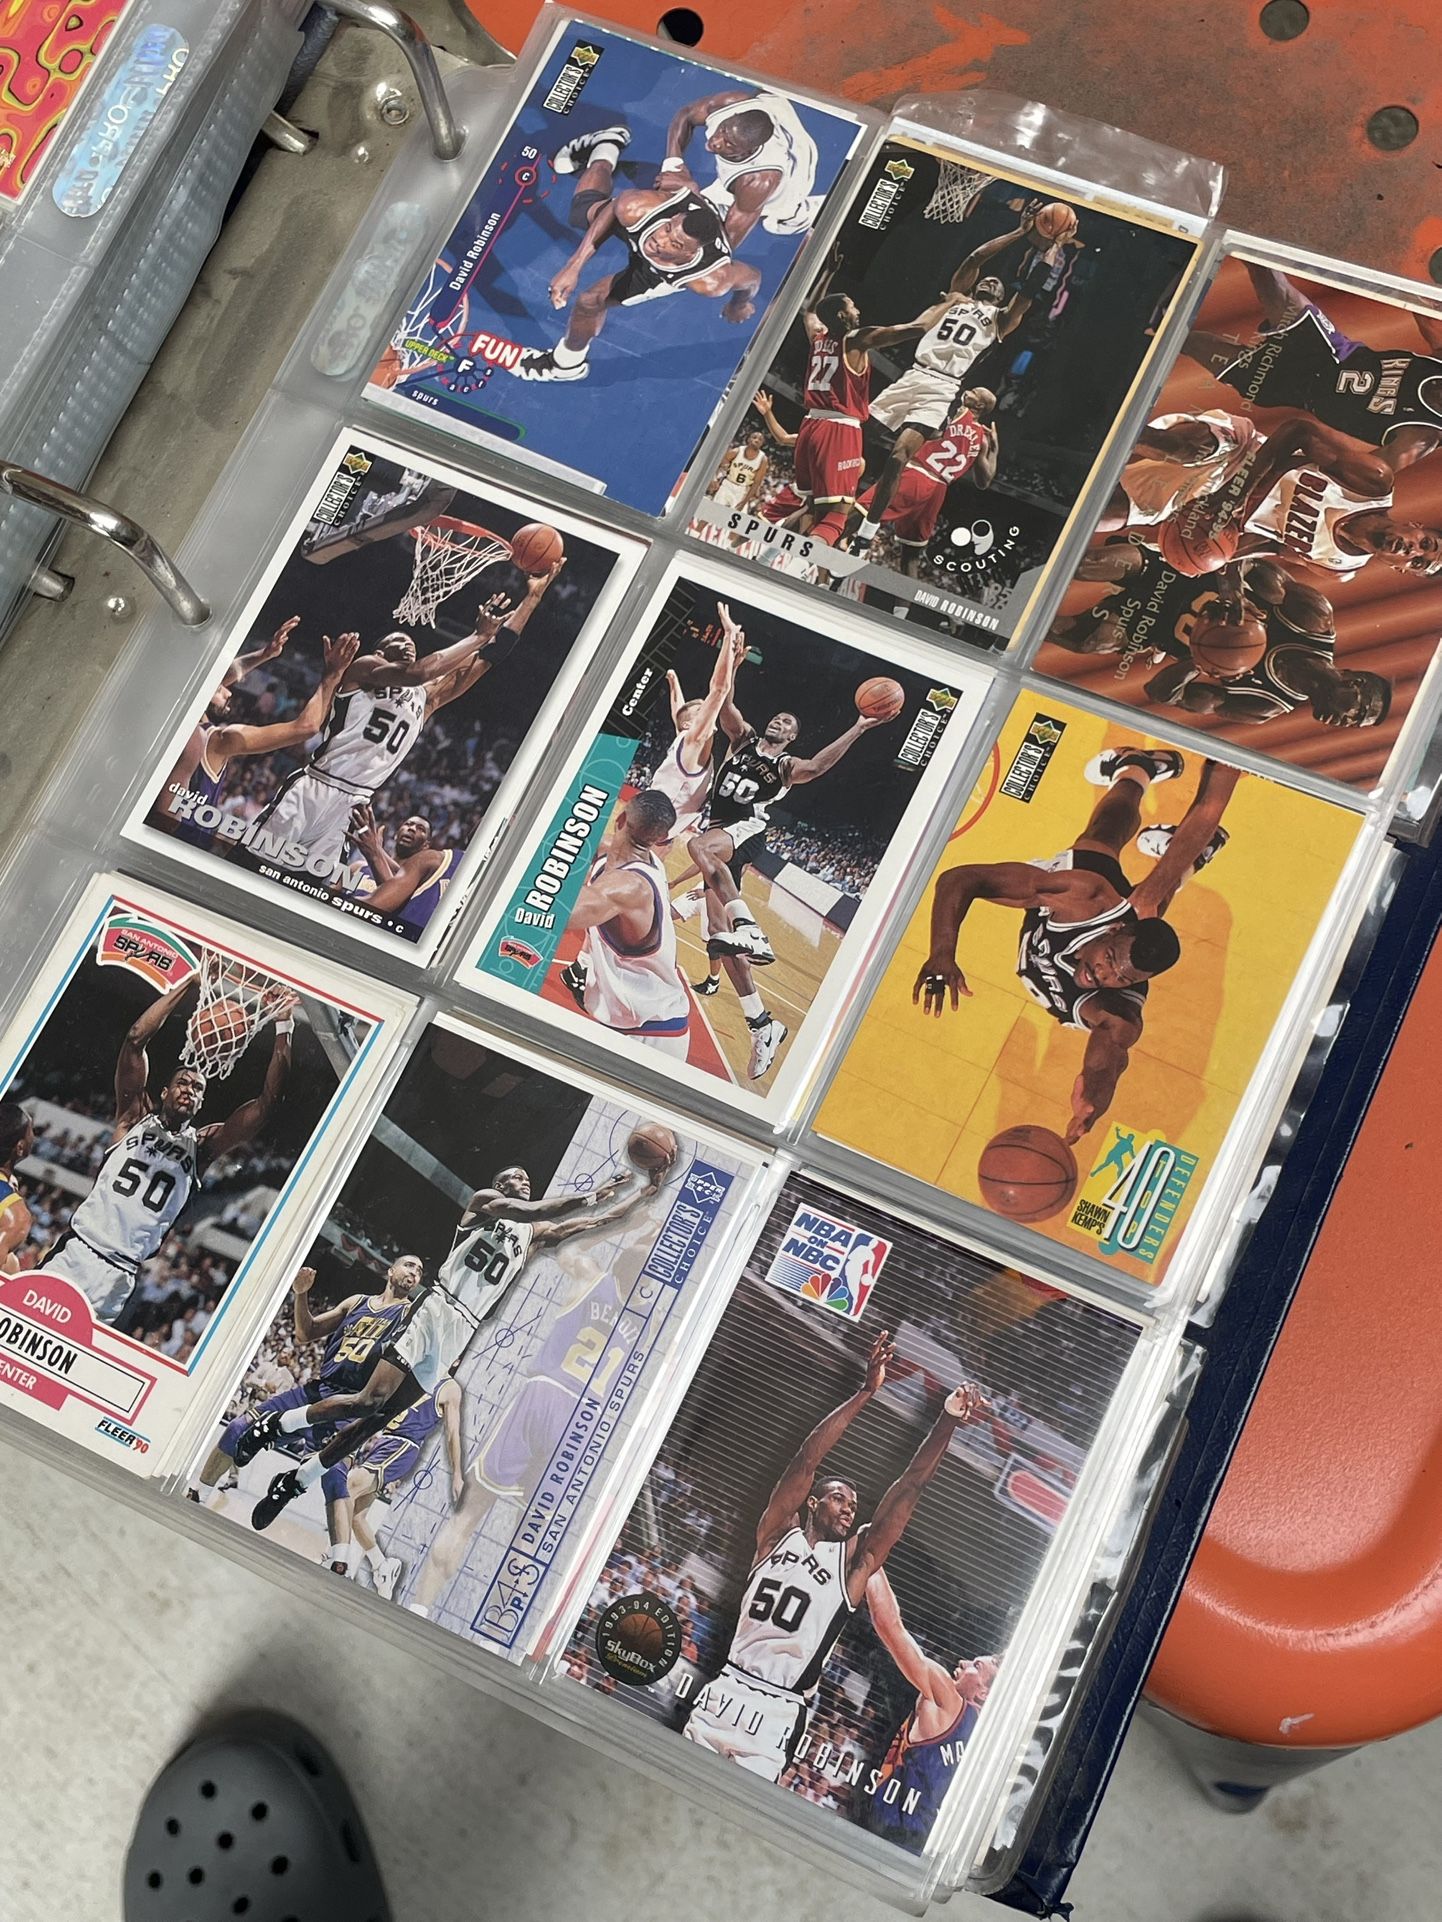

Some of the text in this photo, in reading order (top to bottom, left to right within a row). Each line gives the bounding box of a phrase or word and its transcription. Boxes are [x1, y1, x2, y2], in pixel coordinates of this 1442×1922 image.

[545, 65, 582, 111] COLLECTOR'S
[563, 67, 590, 114] CHOICE
[521, 145, 537, 159] 50
[860, 180, 898, 228] COLLECTOR'S
[880, 180, 906, 231] CHOICE
[449, 212, 501, 291] David Robinson
[404, 339, 450, 363] UPPER DECK
[471, 334, 519, 368] FUN
[936, 317, 977, 347] 50
[807, 355, 839, 391] 27
[1239, 299, 1298, 413] Mitch Richmond
[412, 389, 439, 406] spurs
[1336, 369, 1376, 396] 2
[1367, 357, 1412, 416] KINGS
[926, 439, 967, 481] 22
[949, 422, 981, 458] DREXLER
[736, 472, 746, 484] 6
[1227, 450, 1256, 496] FLEER
[315, 473, 354, 522] COLLECTOR'S
[333, 474, 363, 526] CHOICE
[727, 512, 814, 557] SPURS
[932, 523, 1021, 574] SCOUTING
[913, 588, 1000, 631] DAVID ROBINSON
[1111, 597, 1142, 640] Spurs
[1113, 569, 1177, 681] David Robinson
[621, 666, 654, 717] Center
[362, 706, 411, 756] 50
[900, 710, 940, 765] COLLECTOR'S
[920, 714, 948, 767] CHOICE
[718, 770, 760, 806] 50
[732, 751, 778, 785] SPURS
[1003, 743, 1043, 797] COLLECTOR'S
[1022, 744, 1051, 800] CHOICE
[168, 781, 208, 806] david
[167, 795, 363, 894] ROBINSON
[524, 783, 609, 913] ROBINSON
[258, 863, 281, 881] san
[281, 874, 330, 902] antonio
[331, 895, 383, 927] spurs
[514, 905, 556, 930] David
[113, 935, 173, 971] SPURS
[121, 929, 179, 959] SAN ANTONIO
[126, 1132, 195, 1174] SPURS
[112, 1157, 177, 1214] 50
[688, 1172, 725, 1194] UPPER
[1102, 1140, 1177, 1252] 40
[793, 1211, 854, 1249] NBA
[1070, 1210, 1106, 1236] KEMP'S
[1077, 1199, 1111, 1223] SHAWN
[1138, 1154, 1197, 1260] DEFENDERS
[464, 1237, 511, 1286] 50
[648, 1203, 703, 1280] COLLECTOR'S
[675, 1213, 713, 1285] CHOICE
[781, 1237, 841, 1272] NBC
[807, 1235, 829, 1250] ON
[22, 1288, 73, 1325] DAVID
[639, 1286, 654, 1300] C
[0, 1316, 79, 1376] OBINSON
[333, 1335, 376, 1364] 50
[561, 1326, 626, 1398] 21
[97, 1419, 137, 1447] FLEER
[542, 1349, 647, 1554] SAN ANTONIO SPURS
[521, 1396, 601, 1545] DAVID ROBINSON
[748, 1577, 812, 1634] 50
[602, 1600, 676, 1668] 1993-94 EDITION
[674, 1672, 923, 1816] DAVID ROBINSON
